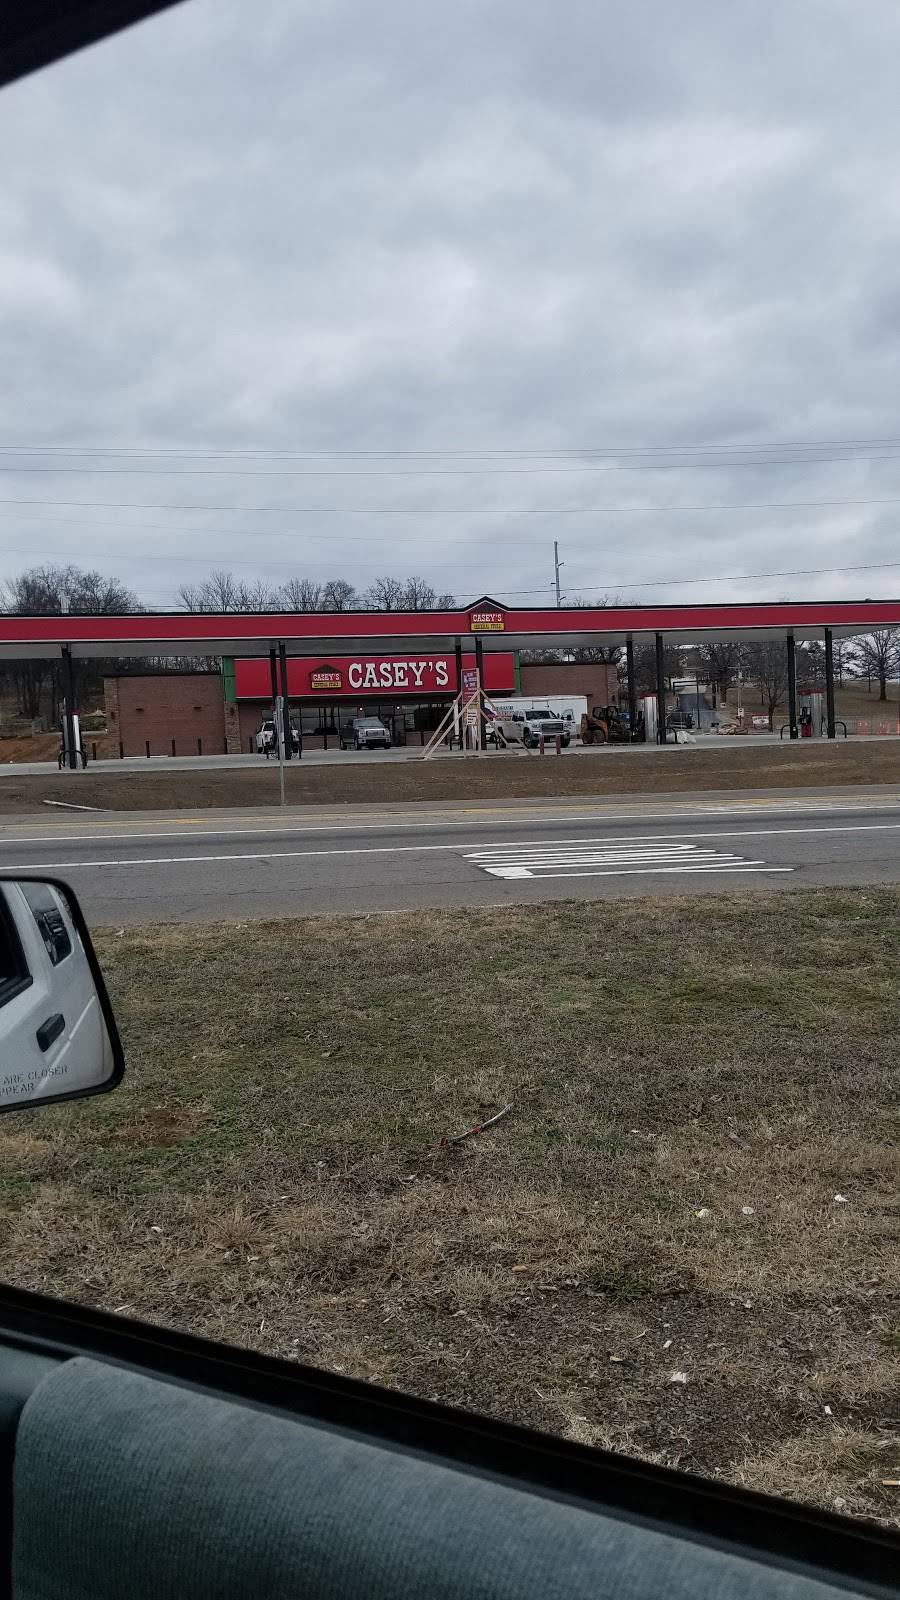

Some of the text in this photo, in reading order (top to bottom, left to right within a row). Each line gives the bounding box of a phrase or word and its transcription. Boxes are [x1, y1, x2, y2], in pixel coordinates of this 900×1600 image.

[472, 614, 502, 622] CASEY'S
[313, 673, 340, 681] CASEY'S
[348, 661, 449, 689] CASEY'S
[3, 1065, 70, 1084] ARE CLOSER
